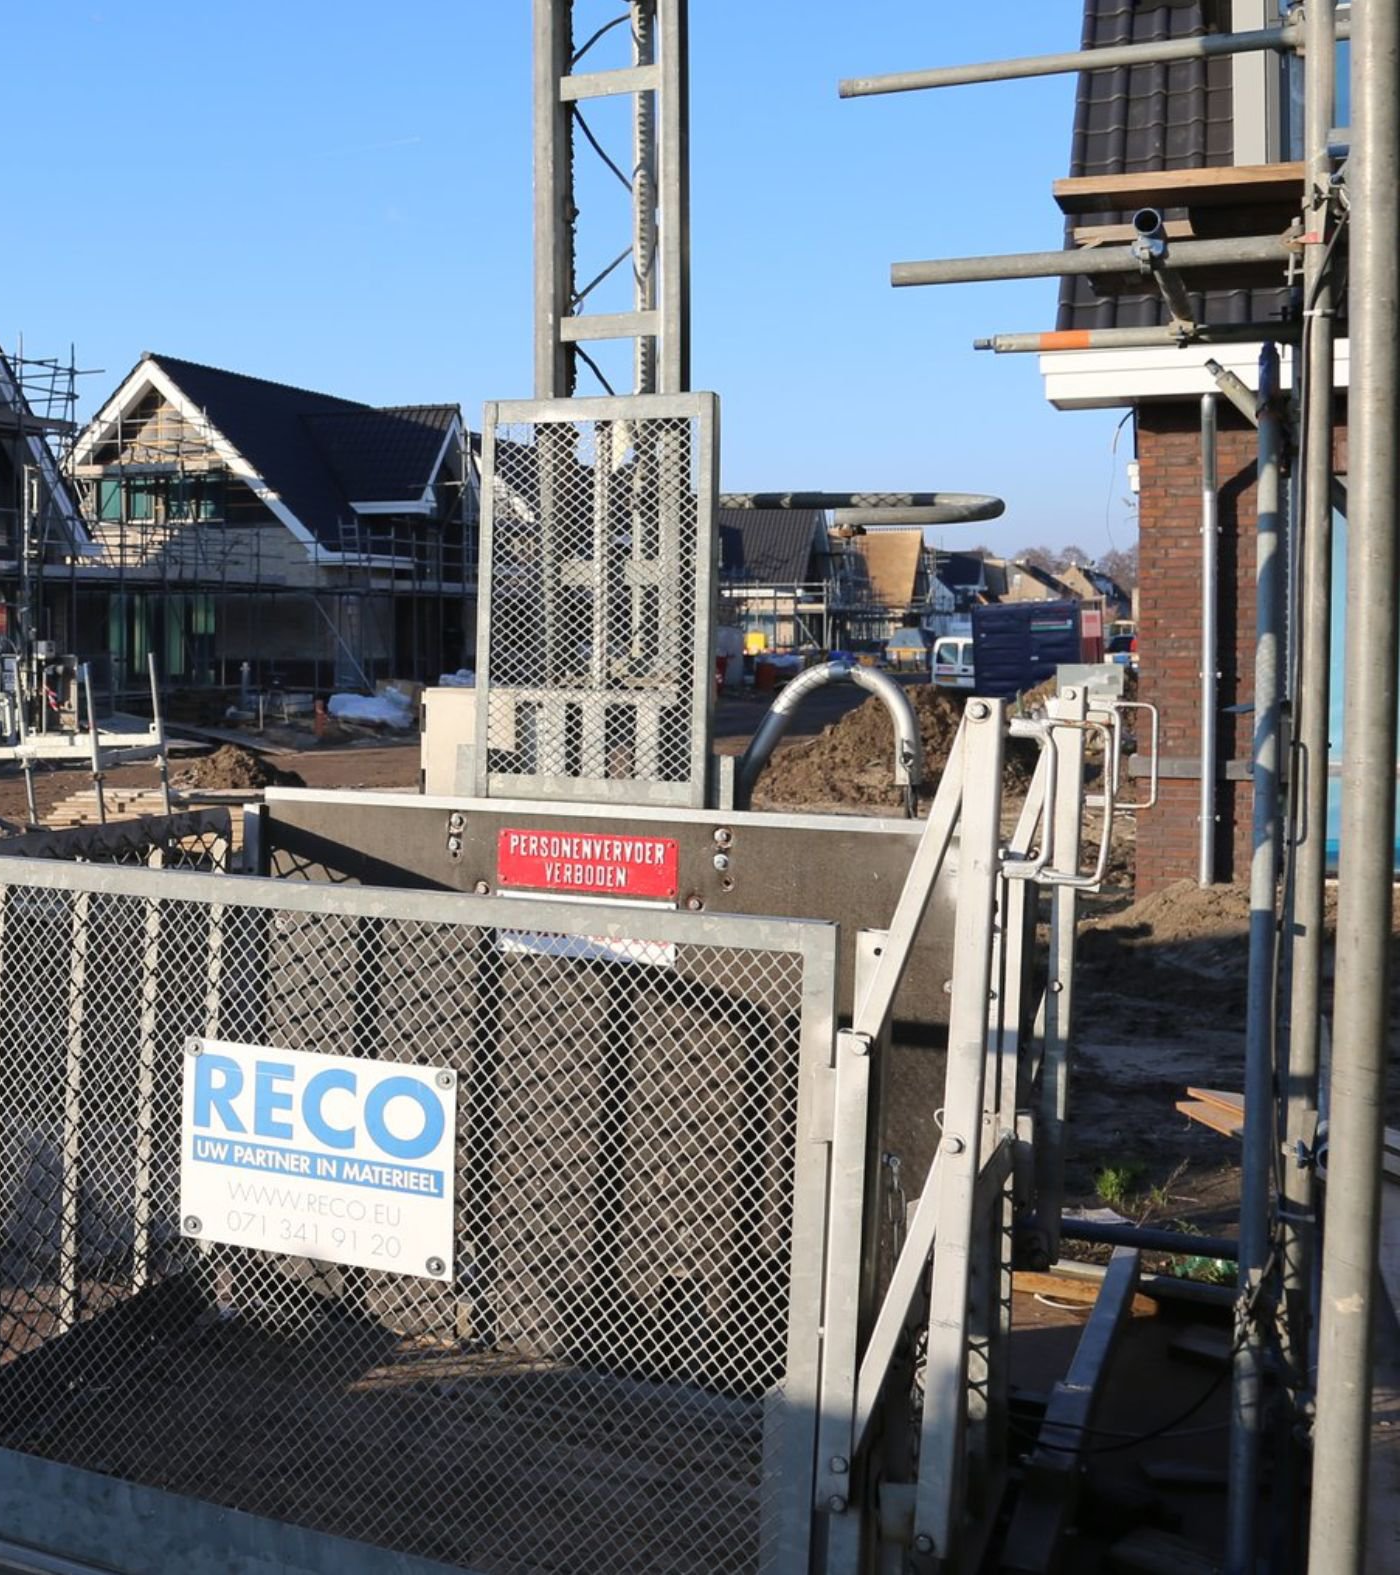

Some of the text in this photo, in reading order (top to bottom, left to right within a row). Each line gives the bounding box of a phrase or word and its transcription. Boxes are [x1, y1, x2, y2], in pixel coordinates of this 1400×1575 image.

[510, 834, 665, 865] PERSONENVERVOER
[545, 862, 628, 888] VERBODEN
[193, 1053, 445, 1160] RECO
[197, 1140, 439, 1194] UW PARTNER IN MATERIEEL
[228, 1180, 401, 1228] WWW.RECO.EU
[227, 1210, 401, 1259] 071 341 91 20
